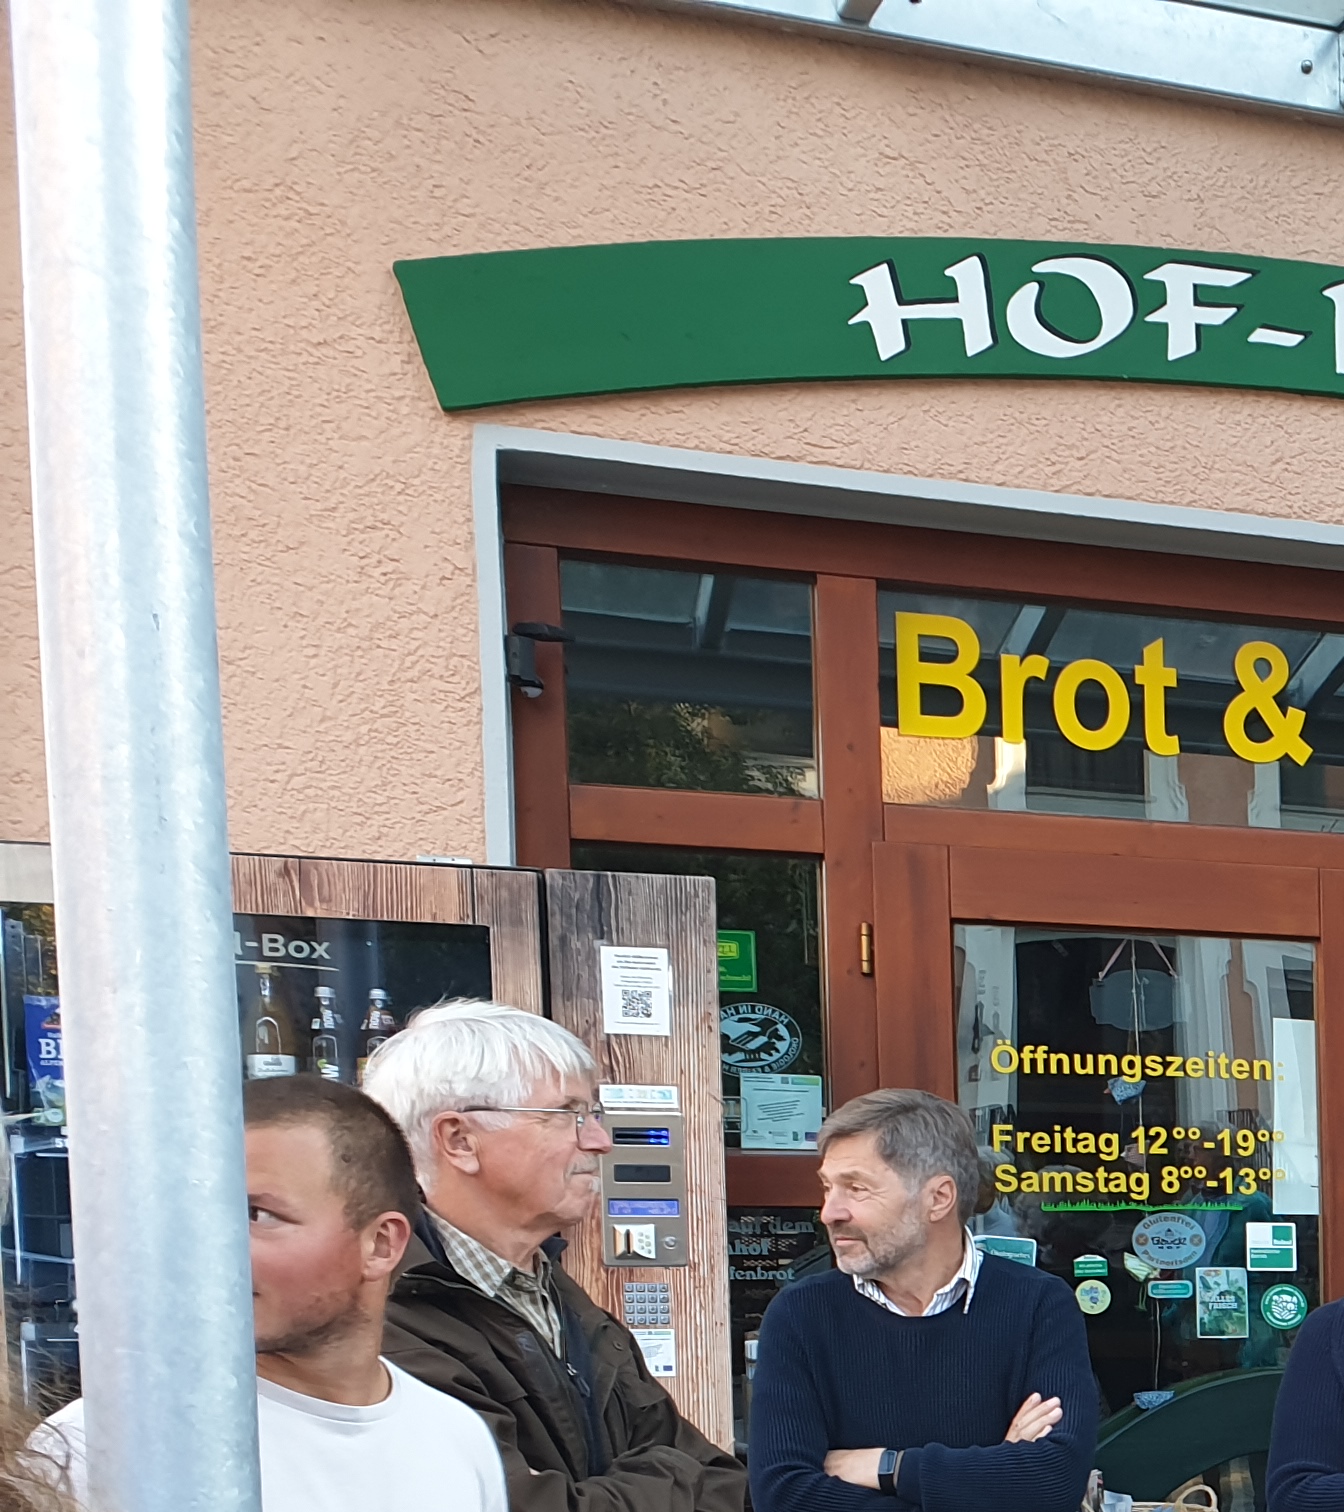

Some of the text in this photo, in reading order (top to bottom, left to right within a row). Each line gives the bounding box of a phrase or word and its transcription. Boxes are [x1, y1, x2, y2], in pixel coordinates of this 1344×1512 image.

[894, 611, 1181, 757] Brot
[1223, 641, 1314, 767] &
[990, 1039, 1285, 1083] Öffnungszeiten:
[992, 1124, 1120, 1161] Freitag
[994, 1164, 1150, 1200] Samstag
